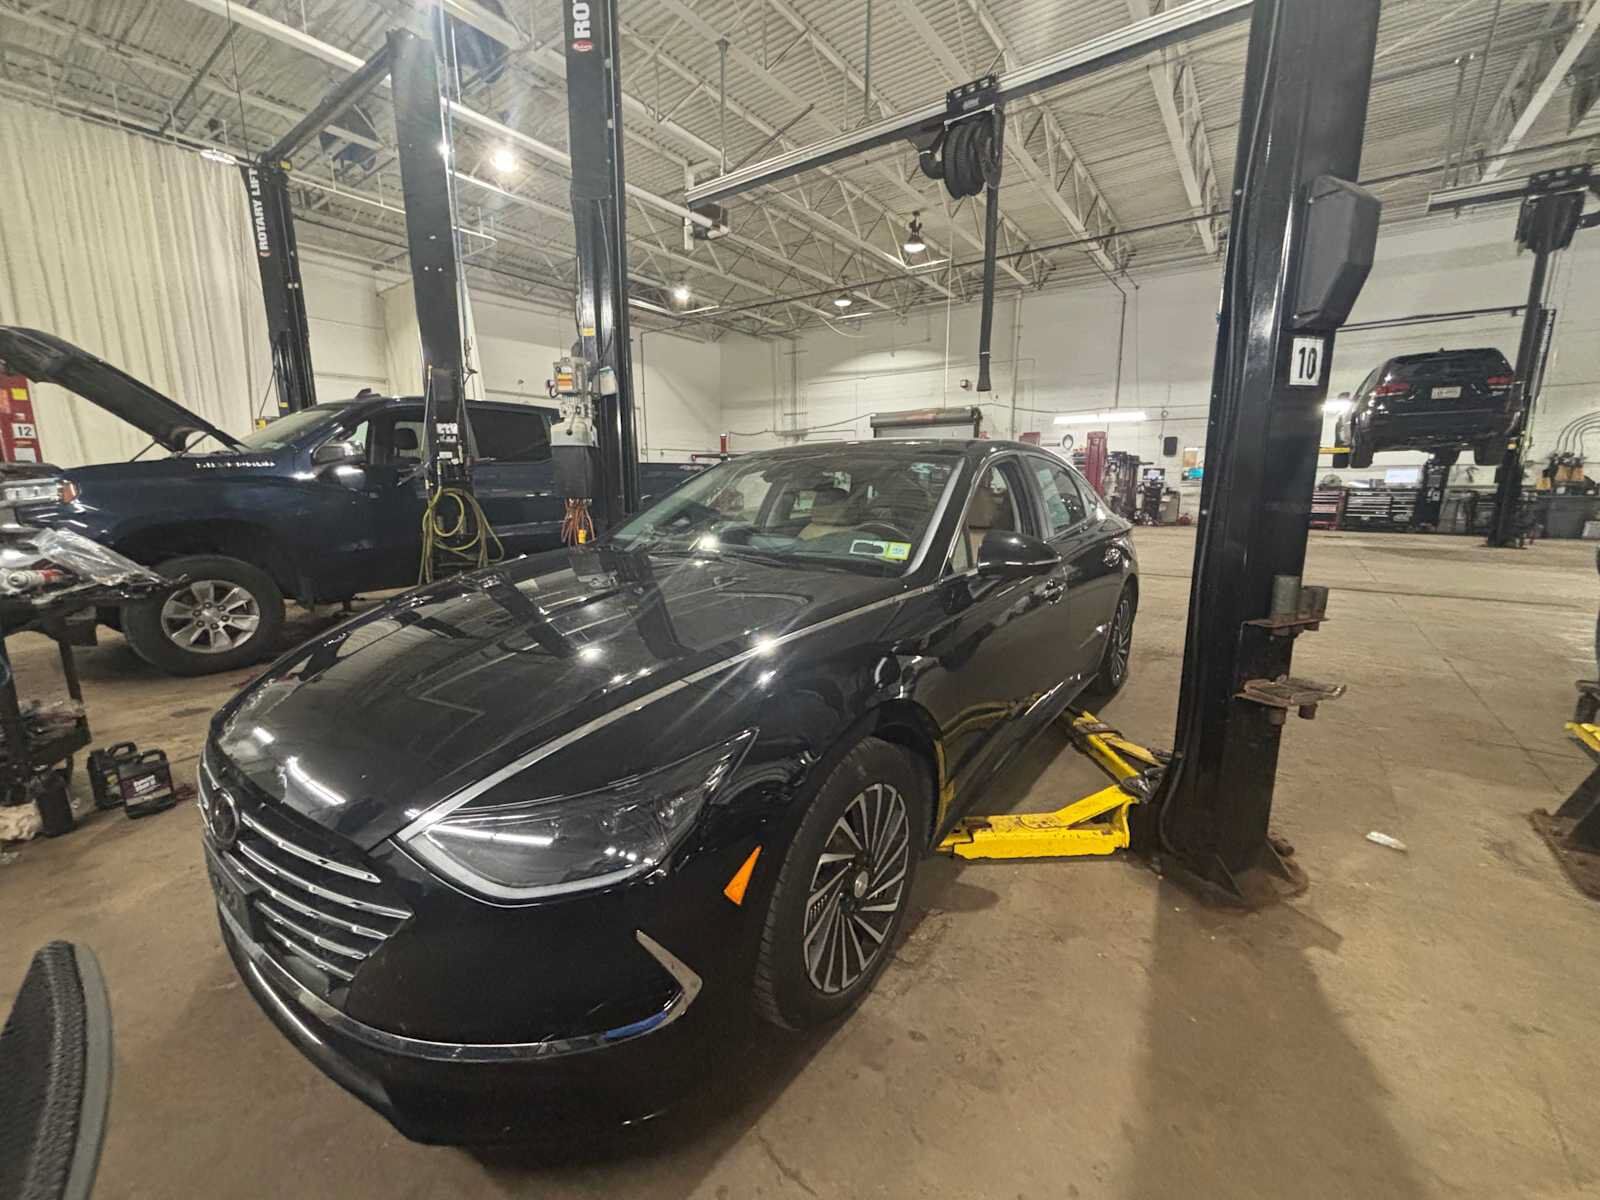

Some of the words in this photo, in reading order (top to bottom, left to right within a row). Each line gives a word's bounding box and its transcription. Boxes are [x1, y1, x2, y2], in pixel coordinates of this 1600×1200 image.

[572, 0, 591, 38] RO
[249, 168, 261, 196] LIFT
[253, 200, 269, 250] ROTARY
[1299, 346, 1317, 380] 10
[18, 426, 32, 437] 12
